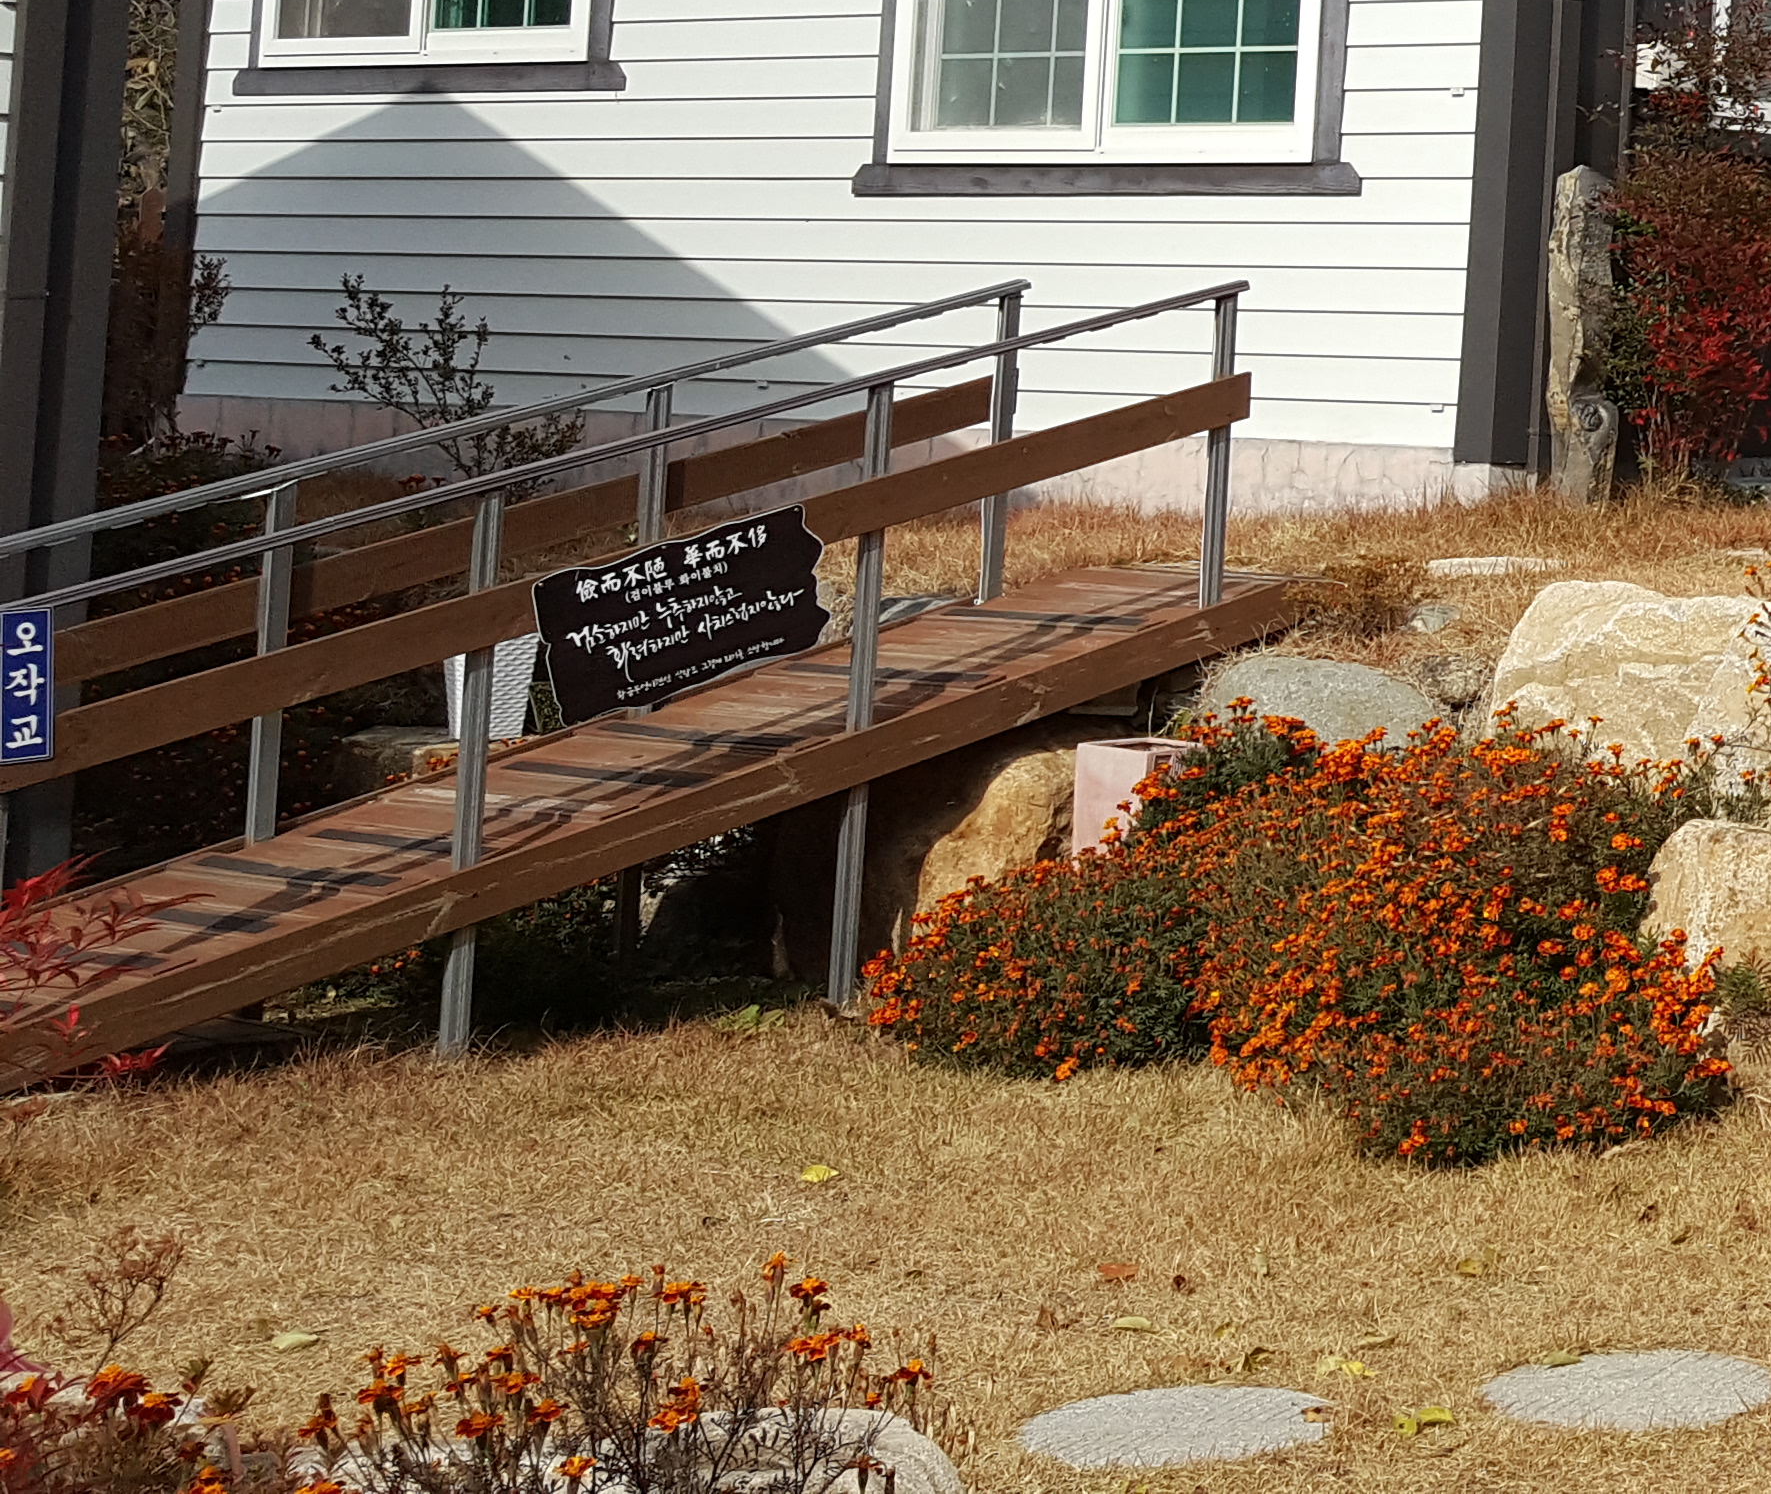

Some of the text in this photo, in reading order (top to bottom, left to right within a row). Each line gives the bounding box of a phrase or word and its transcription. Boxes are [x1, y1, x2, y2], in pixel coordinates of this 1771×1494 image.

[566, 585, 742, 654] 검소하지만 누추하지않고
[5, 621, 45, 749] 오작교
[605, 629, 691, 683] 화려하지만
